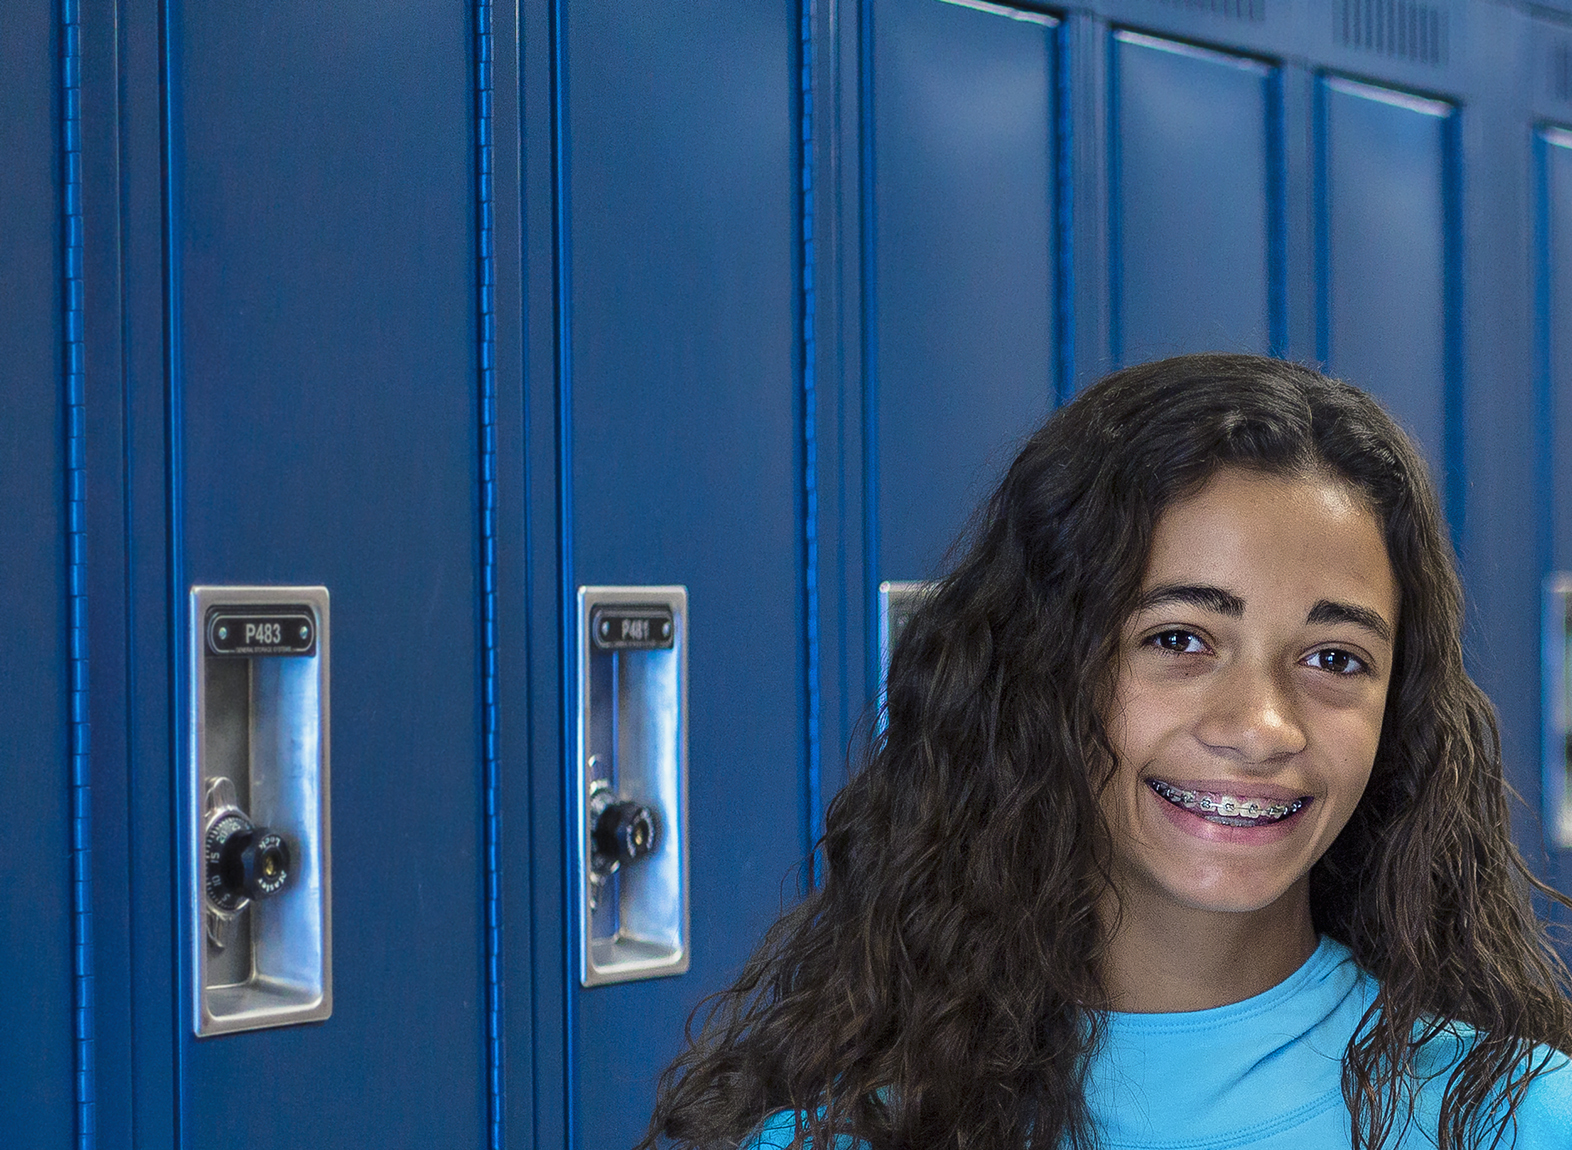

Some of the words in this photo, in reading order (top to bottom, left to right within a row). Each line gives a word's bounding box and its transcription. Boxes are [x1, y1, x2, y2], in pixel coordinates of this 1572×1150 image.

[246, 623, 281, 643] P483
[258, 836, 281, 849] Lock
[210, 852, 220, 863] 15
[211, 875, 222, 887] 10
[258, 870, 287, 893] Master
